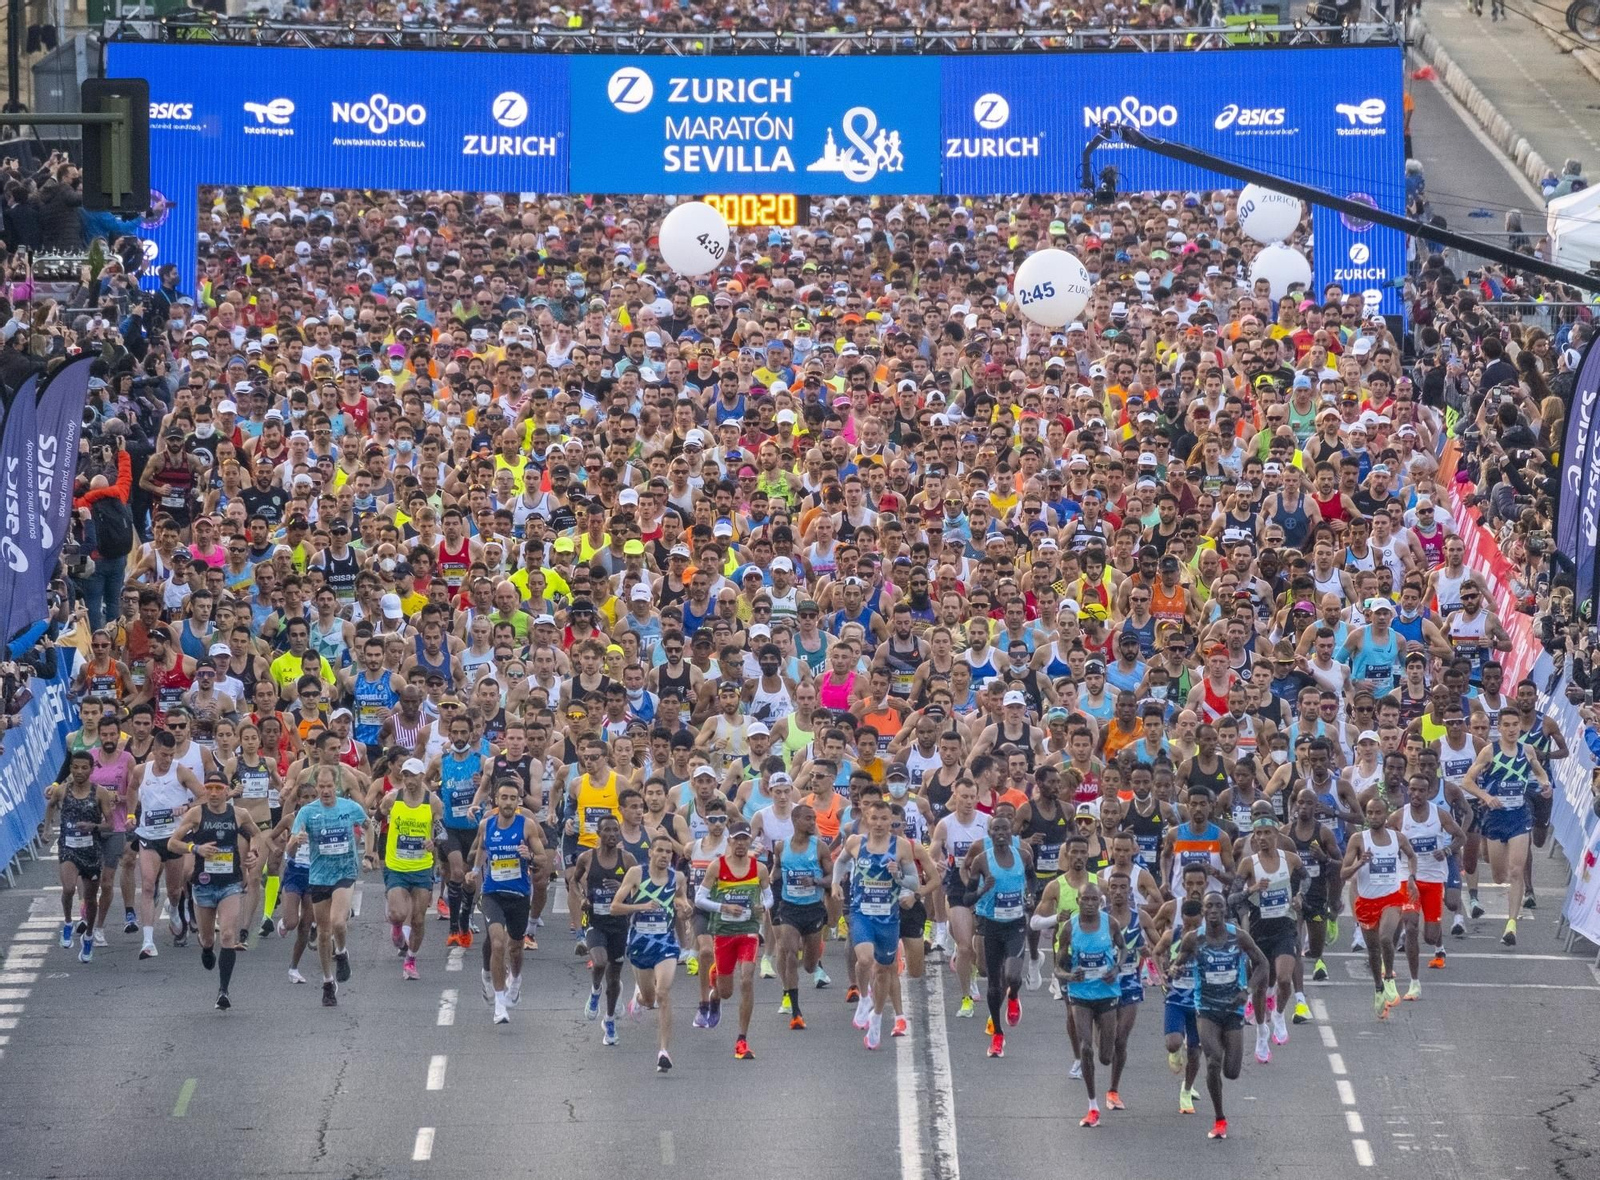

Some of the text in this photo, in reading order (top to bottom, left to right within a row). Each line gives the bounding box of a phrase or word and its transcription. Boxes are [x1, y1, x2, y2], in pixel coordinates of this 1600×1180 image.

[668, 78, 792, 103] ZURICH
[665, 111, 793, 141] MARATÓN
[1237, 108, 1285, 126] asics
[244, 126, 294, 137] TotalEnergies
[1336, 127, 1386, 136] TotalEnergies
[463, 134, 556, 156] ZURICH
[946, 136, 1039, 158] ZURICH
[664, 145, 795, 172] SEVILLA
[696, 233, 724, 260] 4:30
[1334, 268, 1386, 280] ZURICH
[1020, 281, 1055, 305] 2:45
[67, 420, 76, 442] body
[26, 440, 35, 461] body
[64, 442, 73, 467] sound
[6, 456, 20, 535] asics
[58, 492, 66, 518] sound
[203, 822, 236, 831] MARCIN
